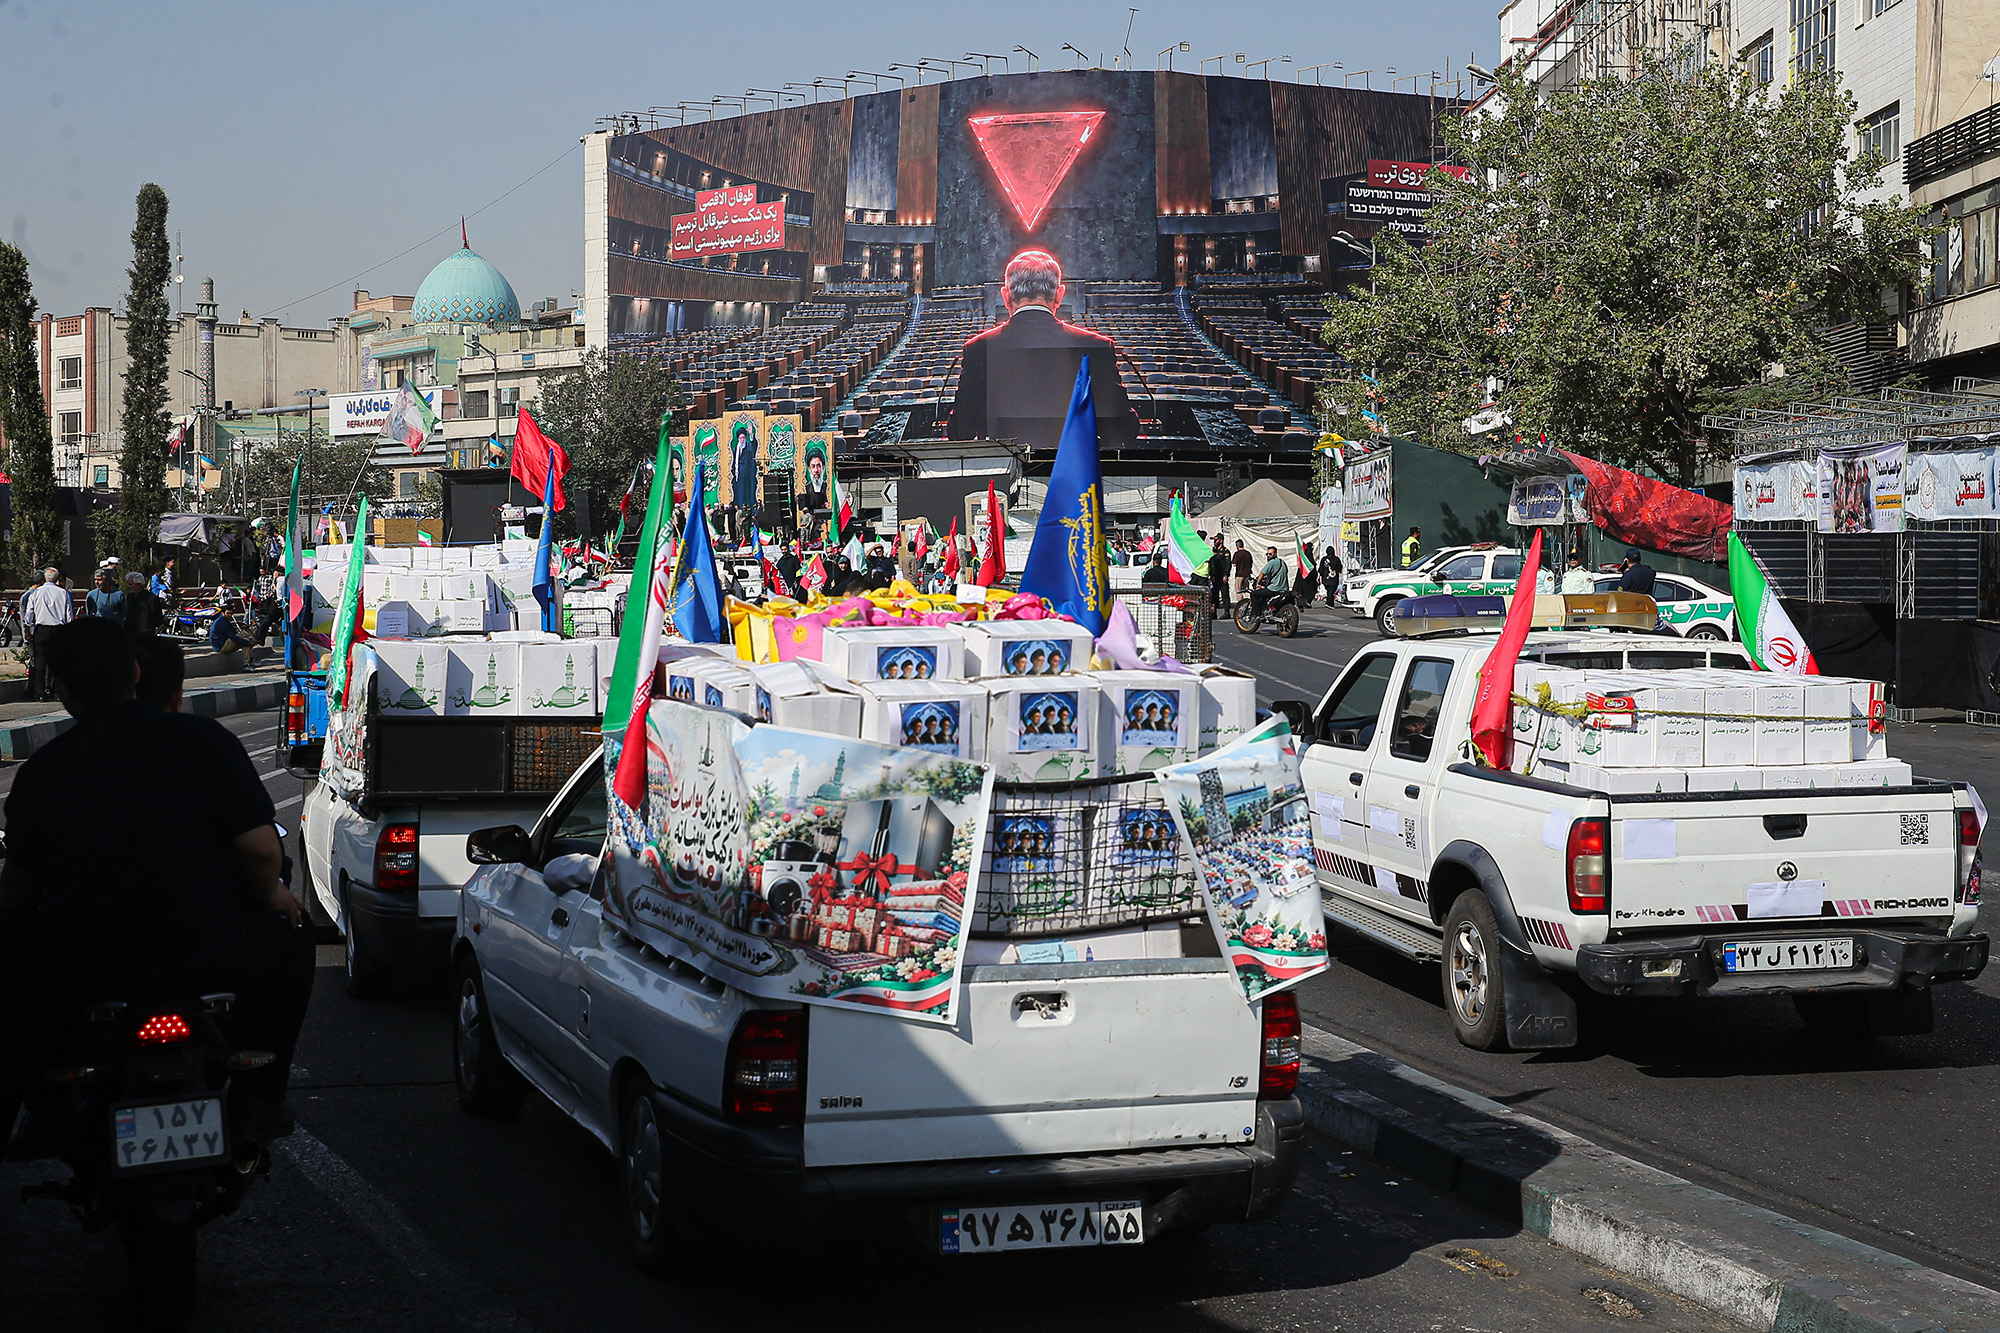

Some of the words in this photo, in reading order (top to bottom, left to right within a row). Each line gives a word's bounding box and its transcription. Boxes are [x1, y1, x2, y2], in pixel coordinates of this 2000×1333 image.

[728, 189, 754, 208] طوفان
[1349, 187, 1393, 199] המרושעת
[699, 193, 727, 212] الاقصی
[1349, 203, 1367, 213] כבר
[1369, 203, 1395, 215] שלכם
[731, 208, 761, 223] شکست
[763, 205, 778, 219] یک
[675, 217, 697, 236] ترمیم
[764, 225, 780, 243] برای
[674, 237, 693, 251] است
[695, 233, 742, 252] صهیونیستی
[744, 229, 763, 248] رژیم
[346, 398, 373, 416] کارگران
[347, 420, 365, 429] REFAH
[1488, 585, 1510, 595] پلیس
[1659, 609, 1673, 620] پلی
[381, 694, 438, 710] محمد
[455, 692, 511, 710] محمد
[533, 692, 589, 709] محمد
[1224, 725, 1245, 735] رزمایش
[715, 789, 742, 835] رزمایش
[706, 830, 730, 864] کمک
[725, 848, 732, 872] و
[1738, 946, 1762, 967] ۳۳
[1767, 946, 1781, 966] ل
[1788, 944, 1824, 966] ۴۱۴
[819, 1095, 863, 1109] SAIPA
[153, 1100, 208, 1130] ۱۵۷
[121, 1130, 219, 1165] ۴۶۸۳۷
[962, 1212, 999, 1247] ۹۷
[1040, 1207, 1097, 1242] ۳۶۸
[1103, 1212, 1139, 1242] ۵۵
